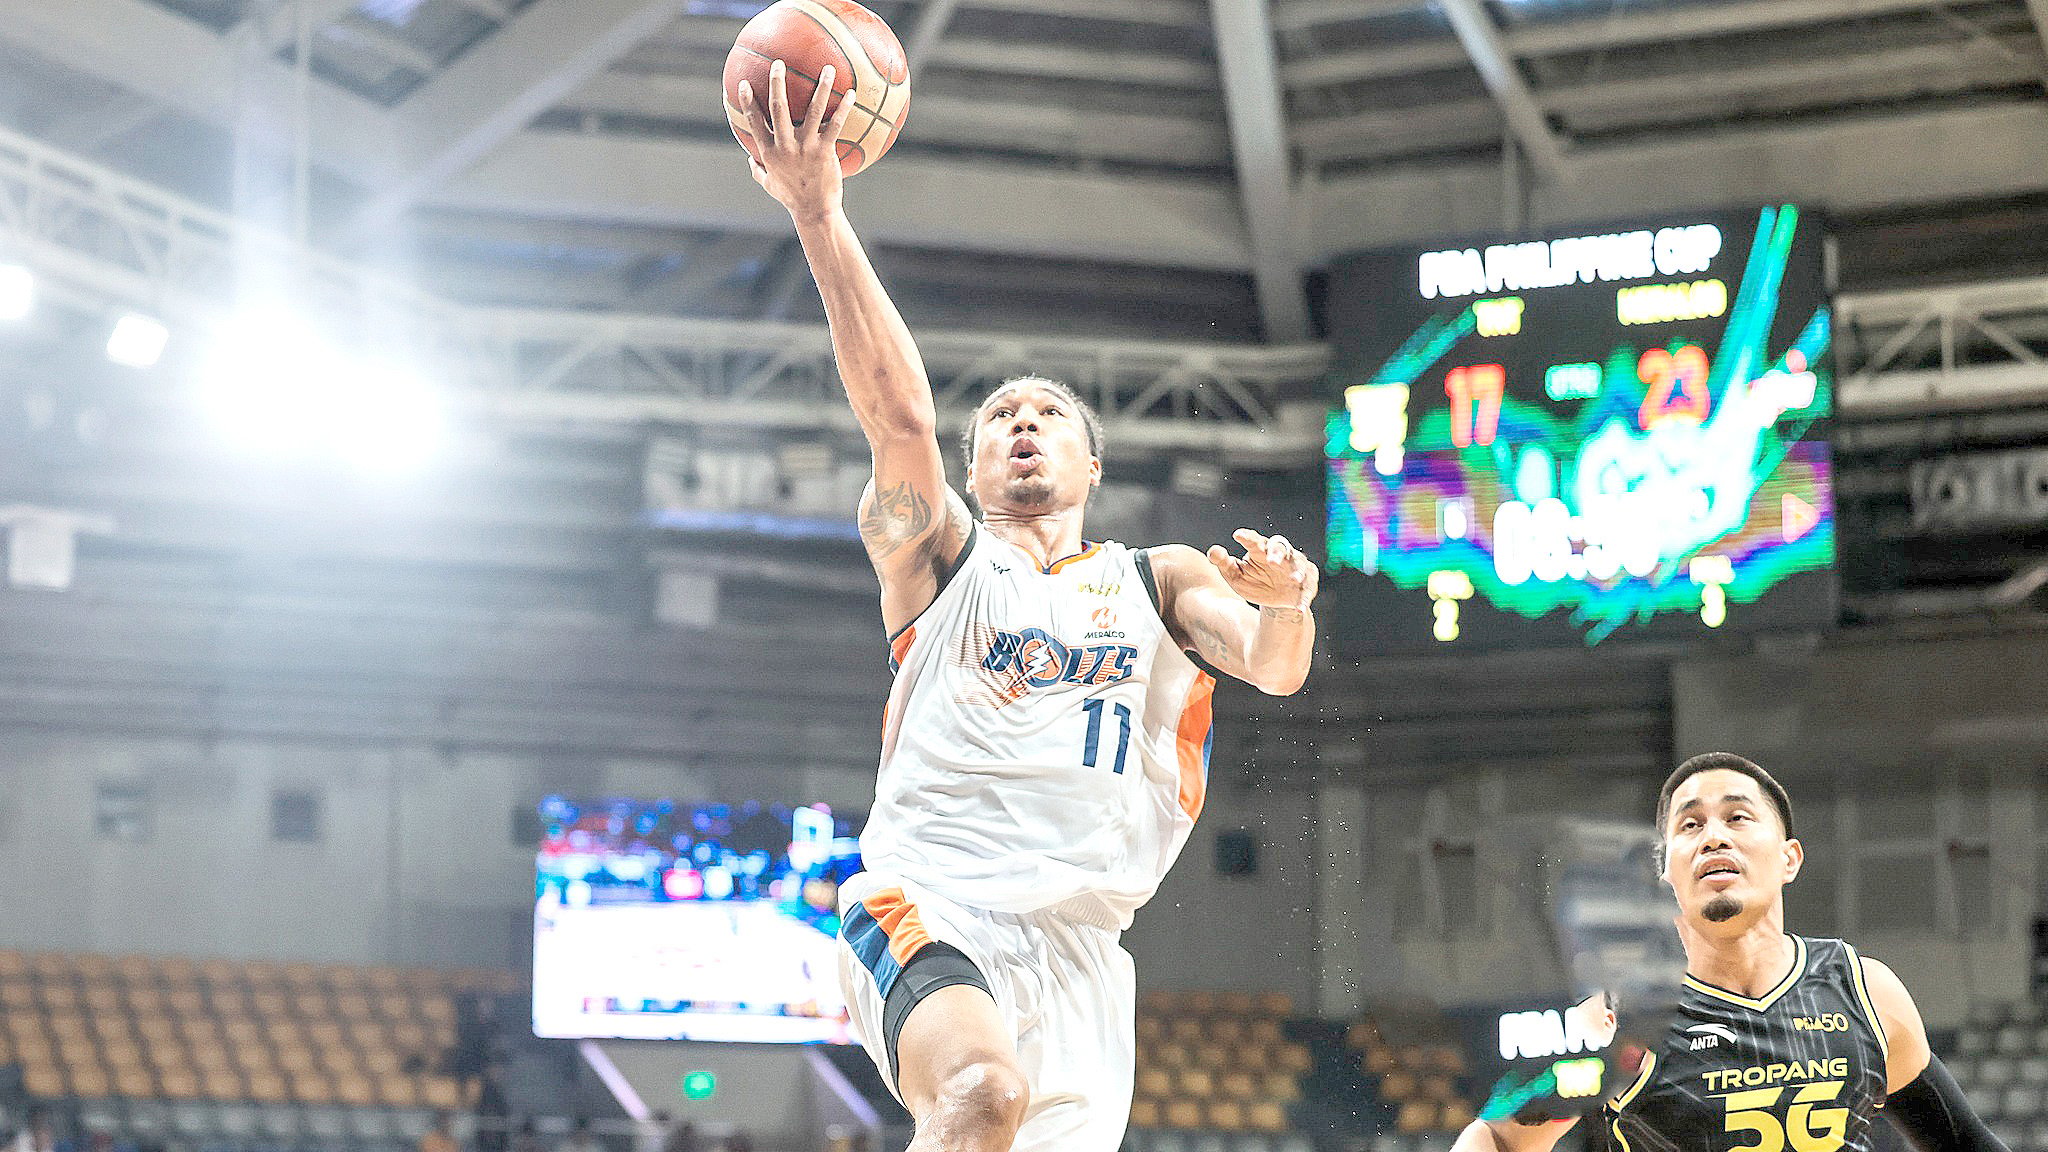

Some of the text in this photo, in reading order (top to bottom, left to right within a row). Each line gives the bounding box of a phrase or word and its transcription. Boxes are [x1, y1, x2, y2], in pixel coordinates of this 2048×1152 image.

[1445, 365, 1505, 448] 17
[1638, 346, 1711, 430] 23
[981, 626, 1139, 688] BOLTS
[1084, 630, 1125, 639] MERALCO
[1082, 698, 1131, 775] 11
[1690, 1035, 1718, 1050] ANTA
[1701, 1057, 1848, 1091] TROPANG
[1706, 1080, 1850, 1152] 5G
